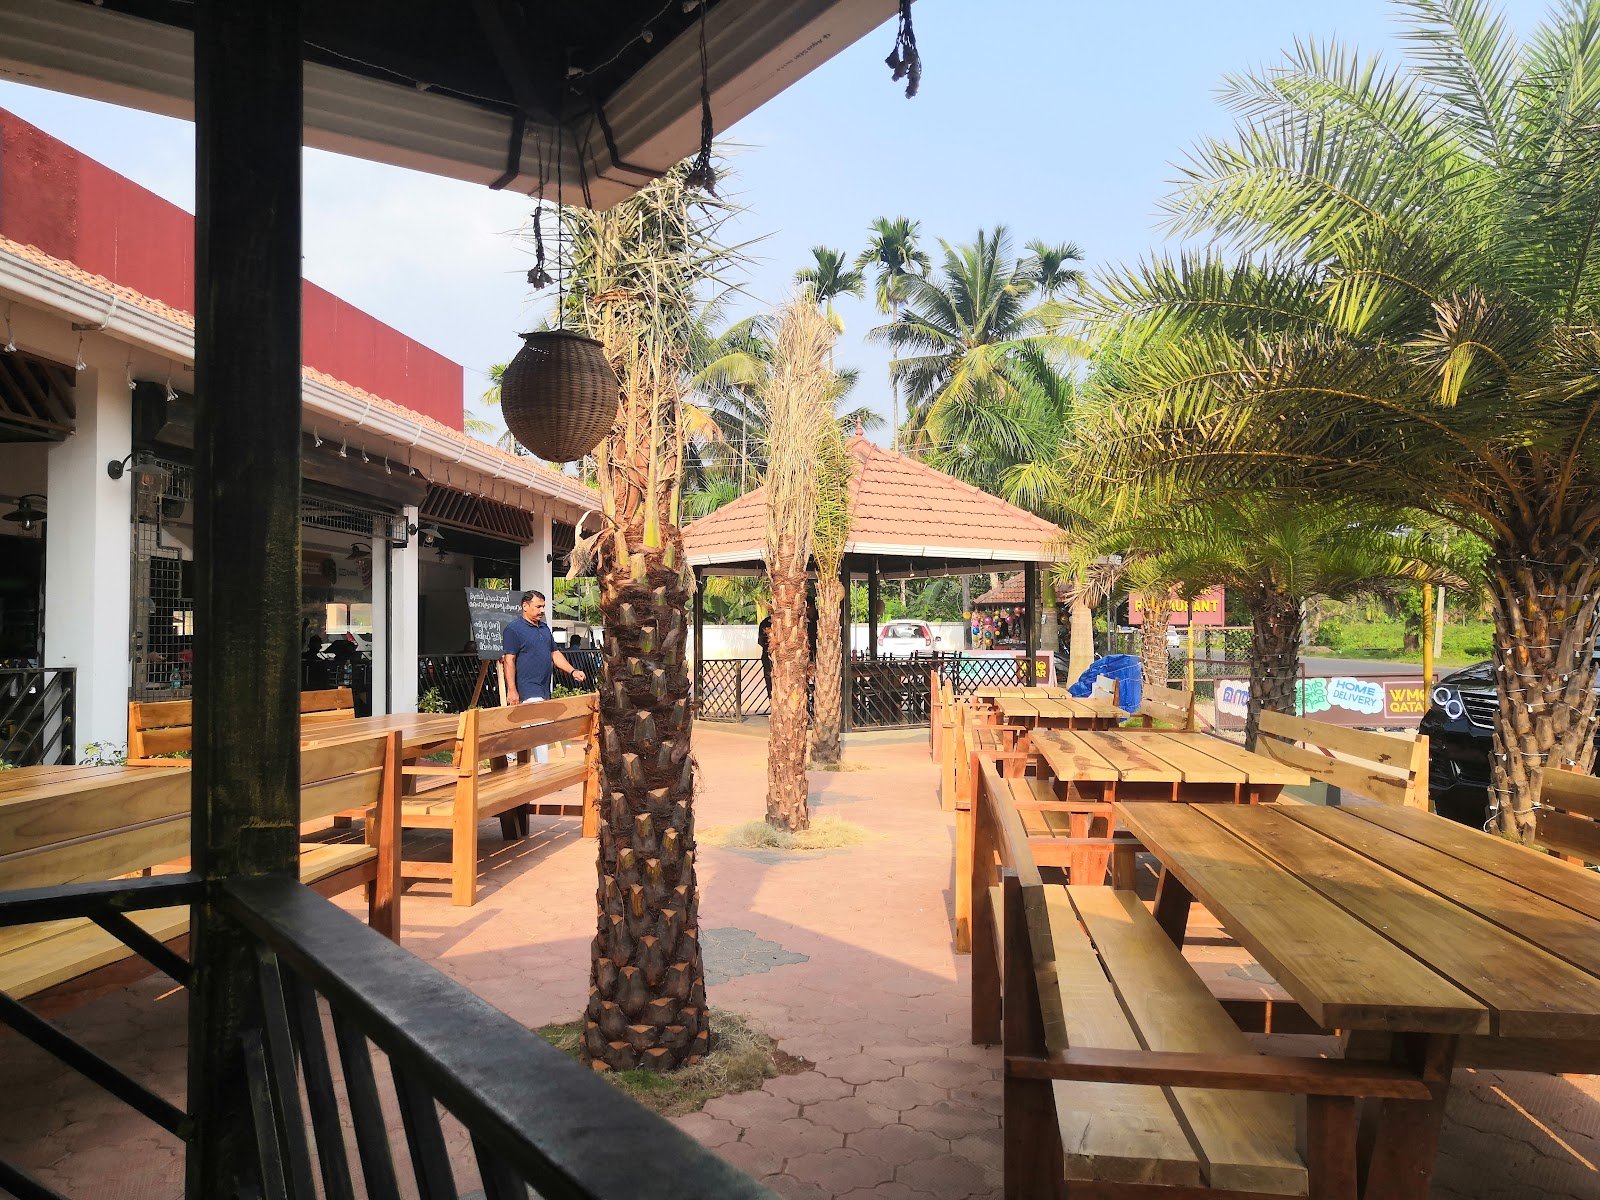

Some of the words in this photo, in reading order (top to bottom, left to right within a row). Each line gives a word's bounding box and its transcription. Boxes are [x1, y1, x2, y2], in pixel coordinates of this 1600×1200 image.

[1336, 680, 1376, 696] HOME
[1333, 690, 1377, 707] DELIVERY
[1389, 702, 1424, 713] QATA
